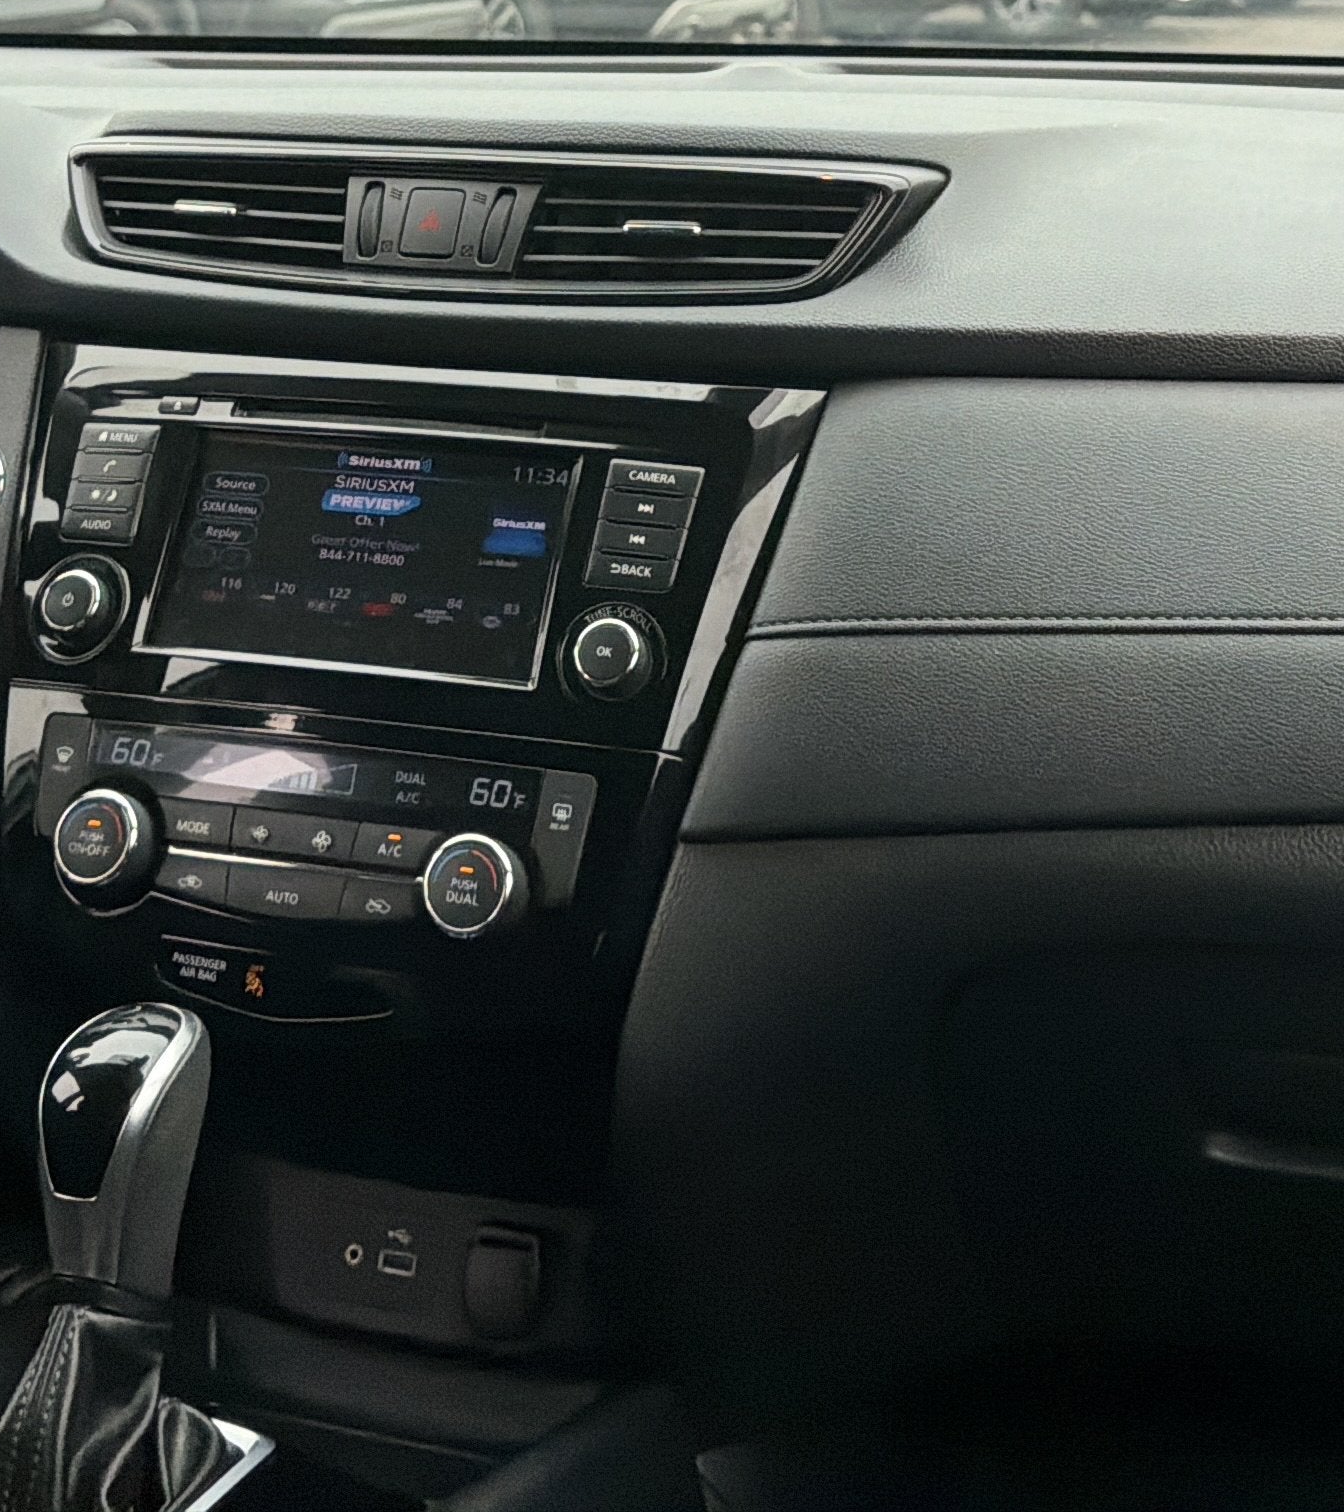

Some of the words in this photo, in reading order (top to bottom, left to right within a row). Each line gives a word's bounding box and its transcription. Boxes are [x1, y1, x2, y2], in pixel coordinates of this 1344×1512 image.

[109, 430, 138, 443] MENU
[334, 474, 415, 494] SIRIUSXM
[512, 466, 569, 487] 11:34
[628, 469, 676, 485] CAMERA
[215, 478, 256, 492] Source
[201, 501, 227, 515] SXM
[228, 503, 258, 516] Menu
[329, 493, 408, 511] PREVIEW
[80, 518, 112, 530] AUDIO
[205, 525, 242, 542] Replay
[319, 548, 405, 567] 844-711-8800
[621, 562, 654, 579] BACK
[221, 576, 243, 591] 116
[274, 581, 297, 596] 120
[328, 585, 352, 600] 122
[390, 592, 407, 606] 80
[446, 597, 463, 611] 84
[596, 646, 614, 658] OK
[394, 770, 426, 786] DUAL
[395, 791, 420, 805] A/C
[176, 819, 211, 835] MODE
[377, 844, 403, 858] A/C
[450, 877, 478, 891] PUSH
[265, 889, 299, 906] AUTO
[445, 890, 479, 906] DUAL
[171, 951, 227, 972] PASSENGER
[179, 965, 196, 979] AIR
[197, 968, 218, 983] BAG
